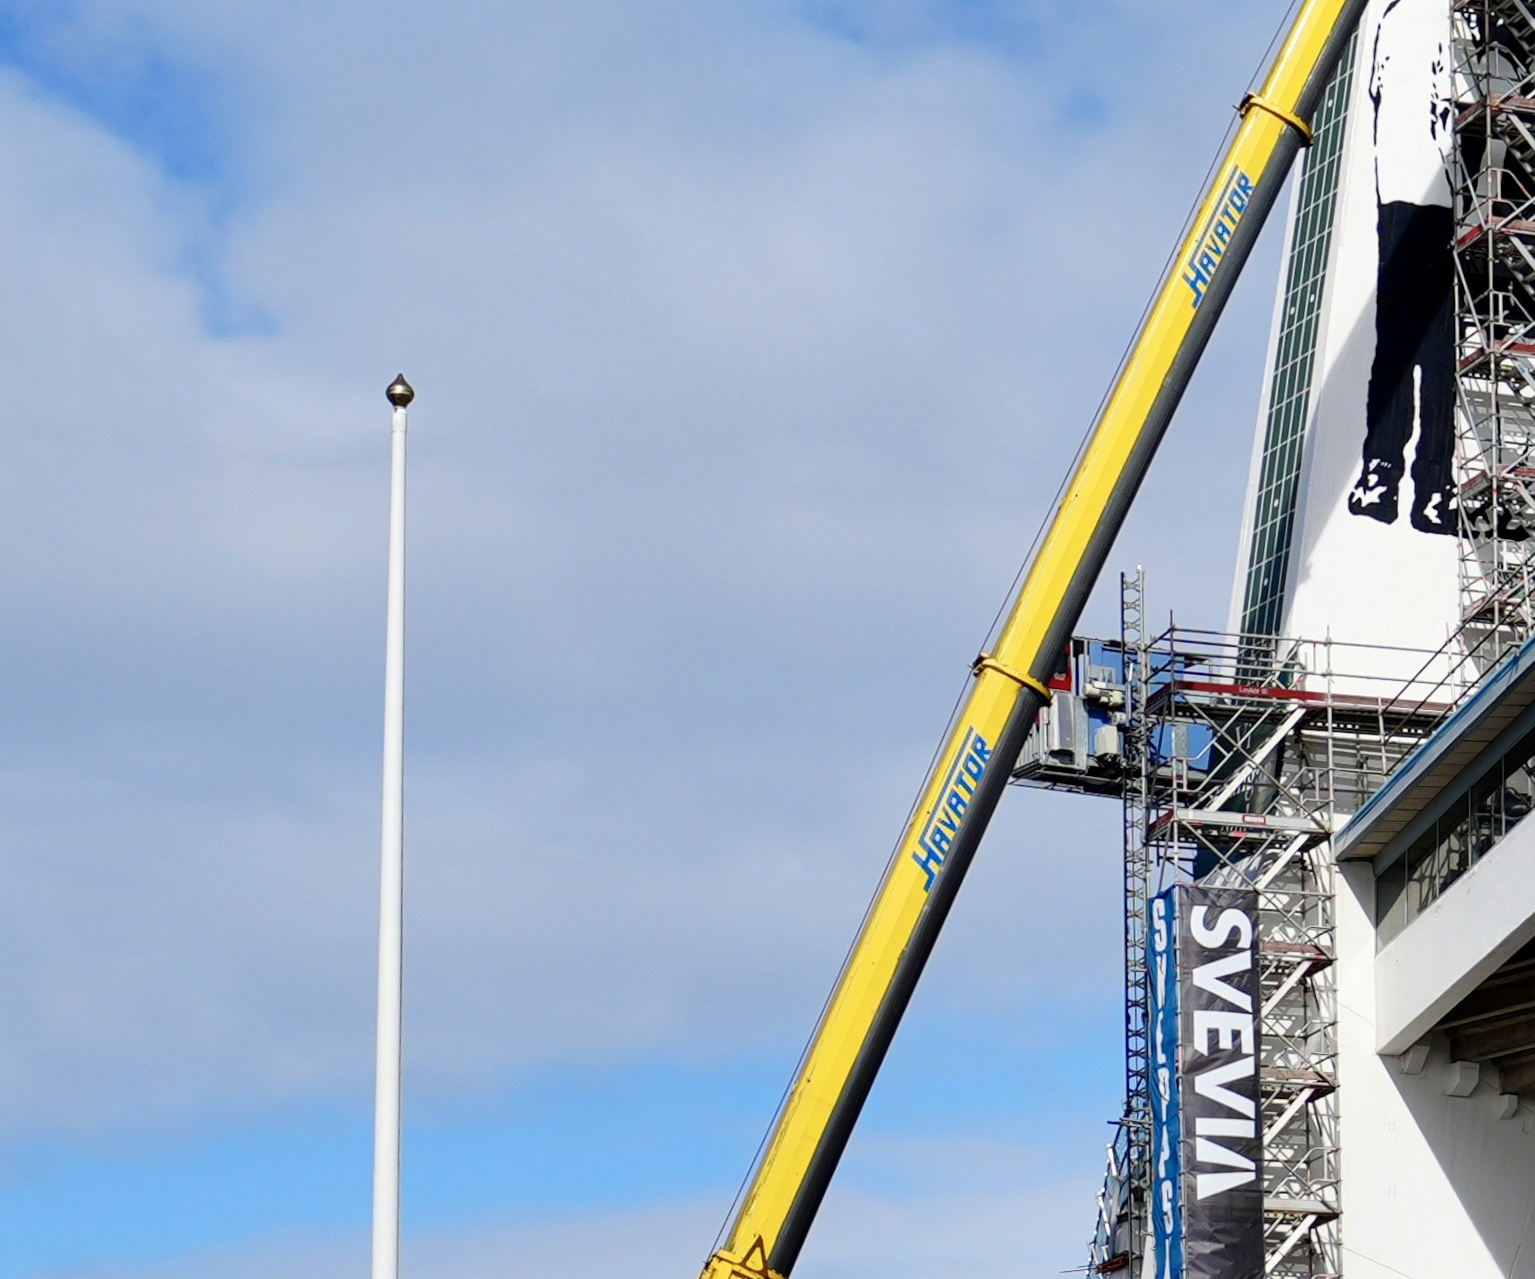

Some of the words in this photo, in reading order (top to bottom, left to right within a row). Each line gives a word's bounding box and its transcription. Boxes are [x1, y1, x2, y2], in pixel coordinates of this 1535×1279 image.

[1182, 164, 1255, 309] HAVATOR
[911, 725, 993, 893] HAVATOR
[1190, 905, 1257, 1200] SVEVIA
